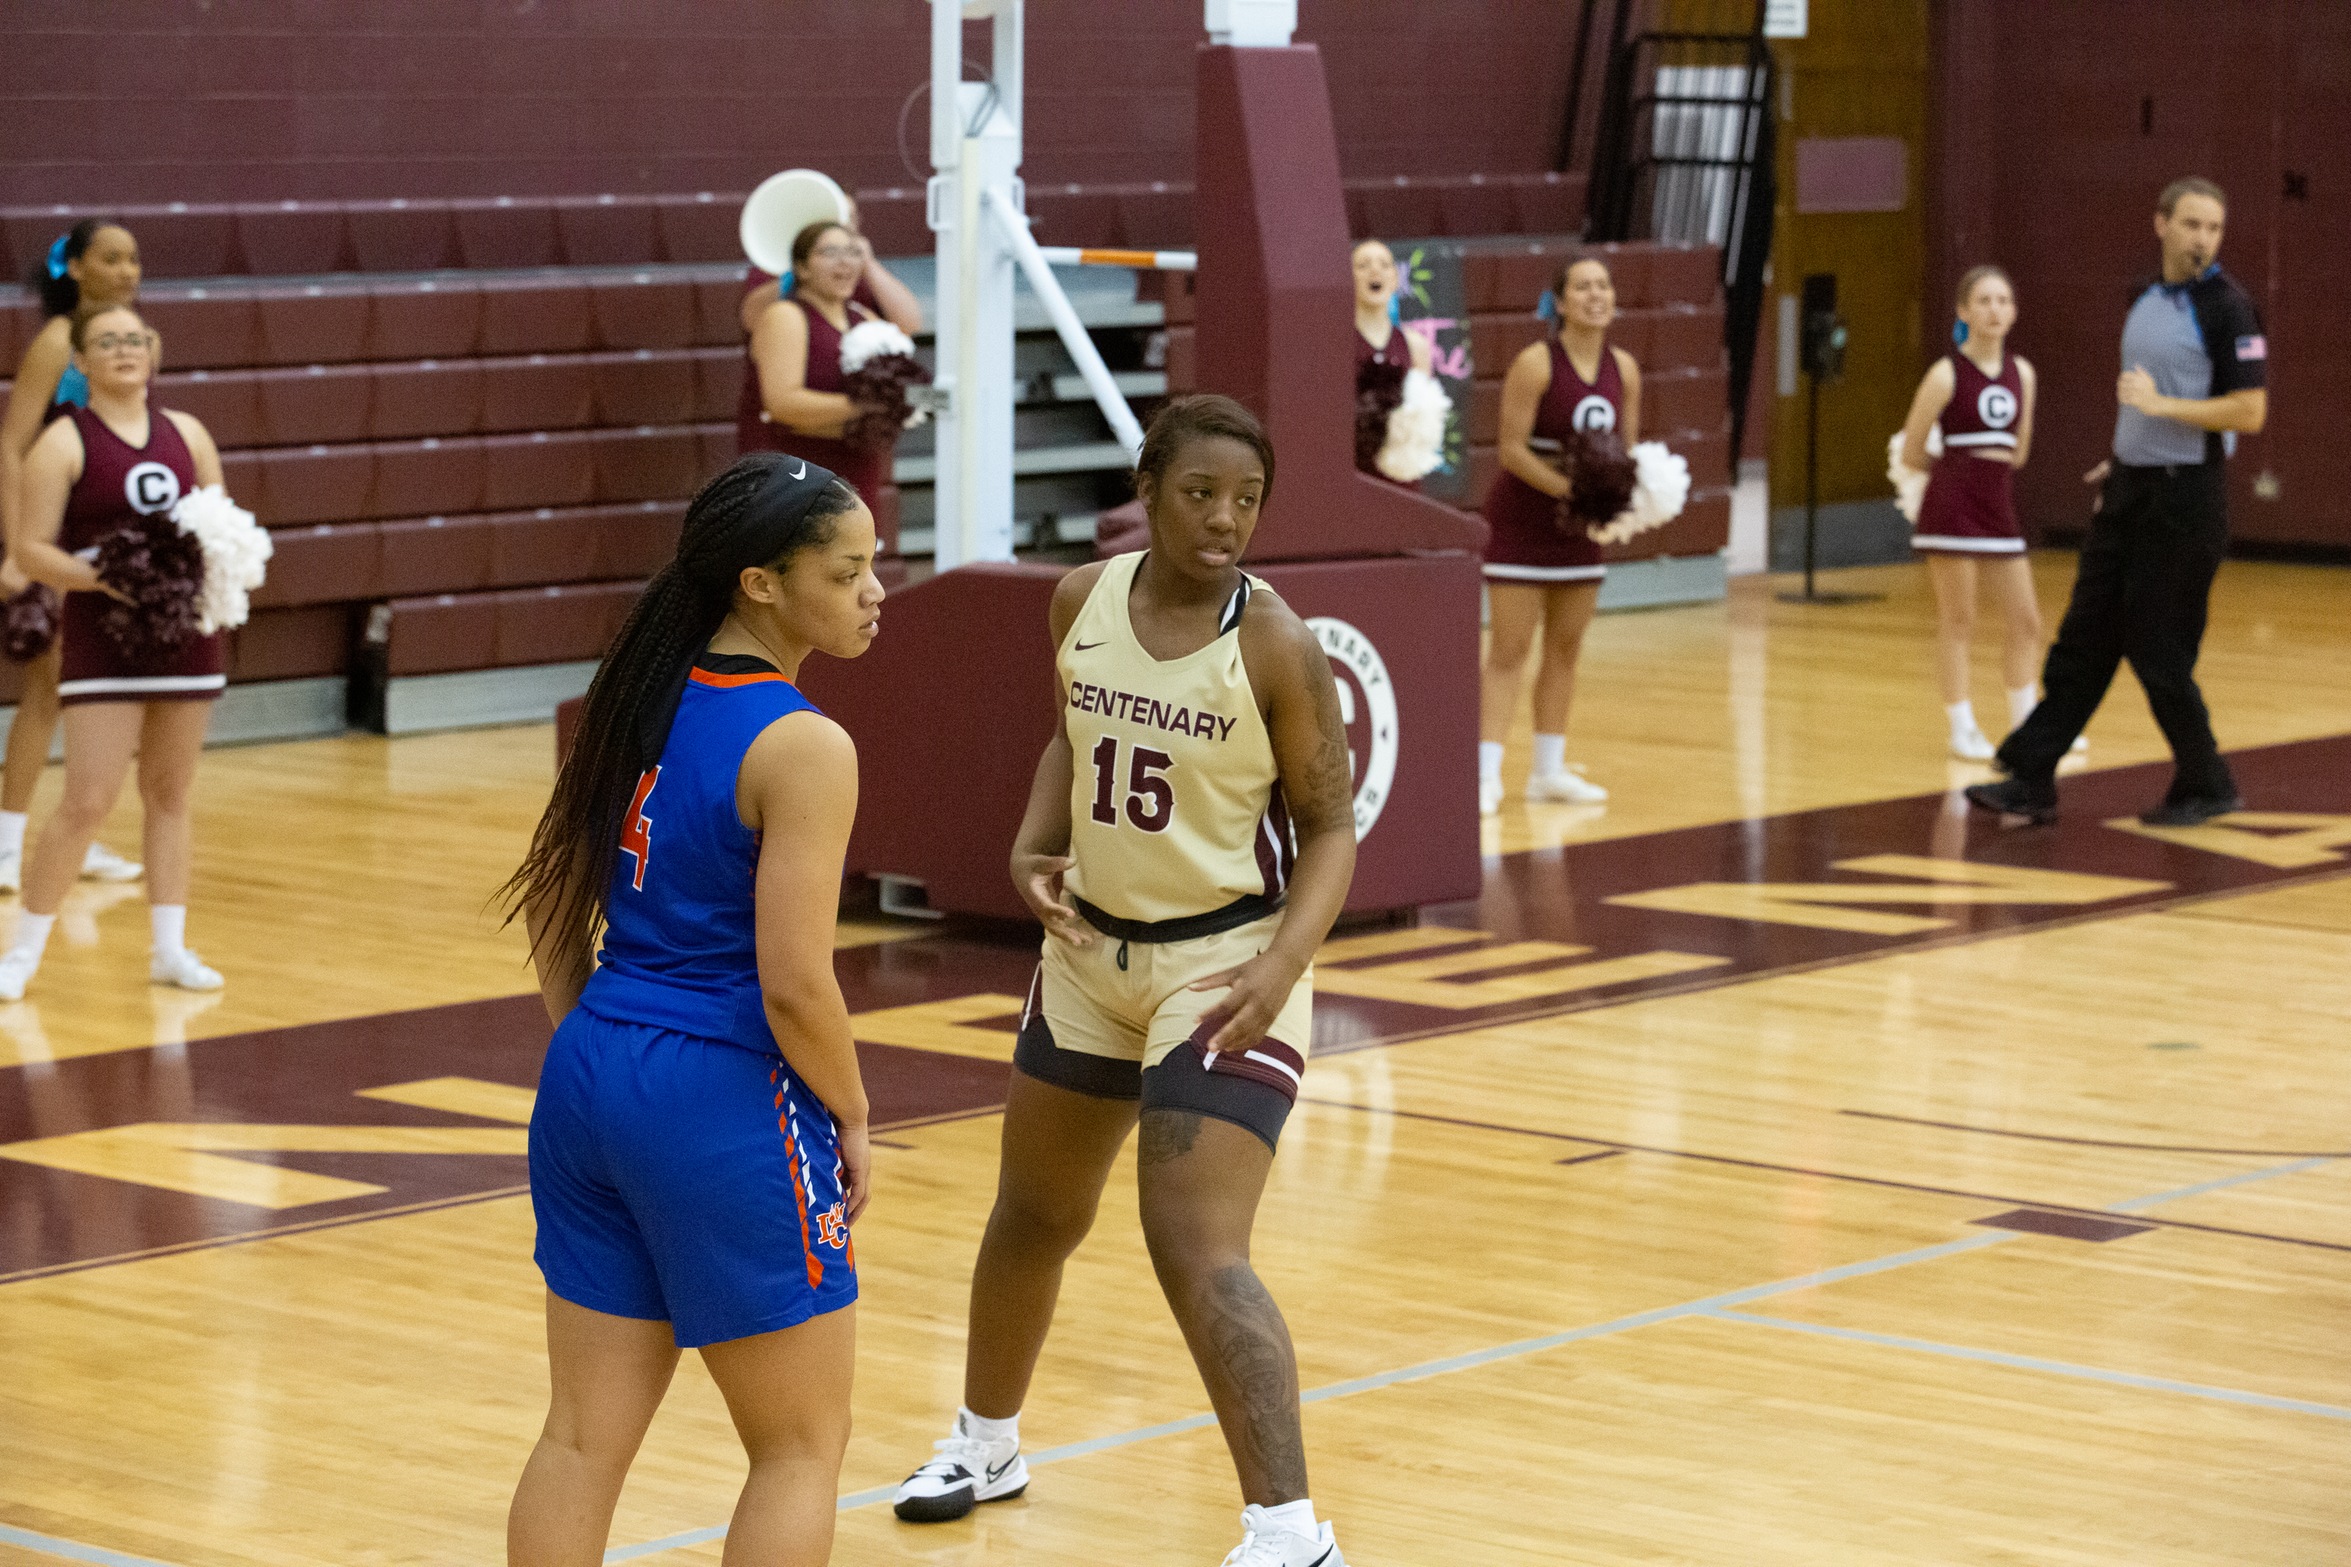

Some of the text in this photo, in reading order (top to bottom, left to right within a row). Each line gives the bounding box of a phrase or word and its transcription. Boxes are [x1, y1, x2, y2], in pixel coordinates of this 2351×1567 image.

[1987, 394, 2008, 419] C
[136, 472, 169, 505] C
[1070, 681, 1237, 742] CENTENARY
[1091, 734, 1177, 833] 15
[619, 764, 662, 892] 4
